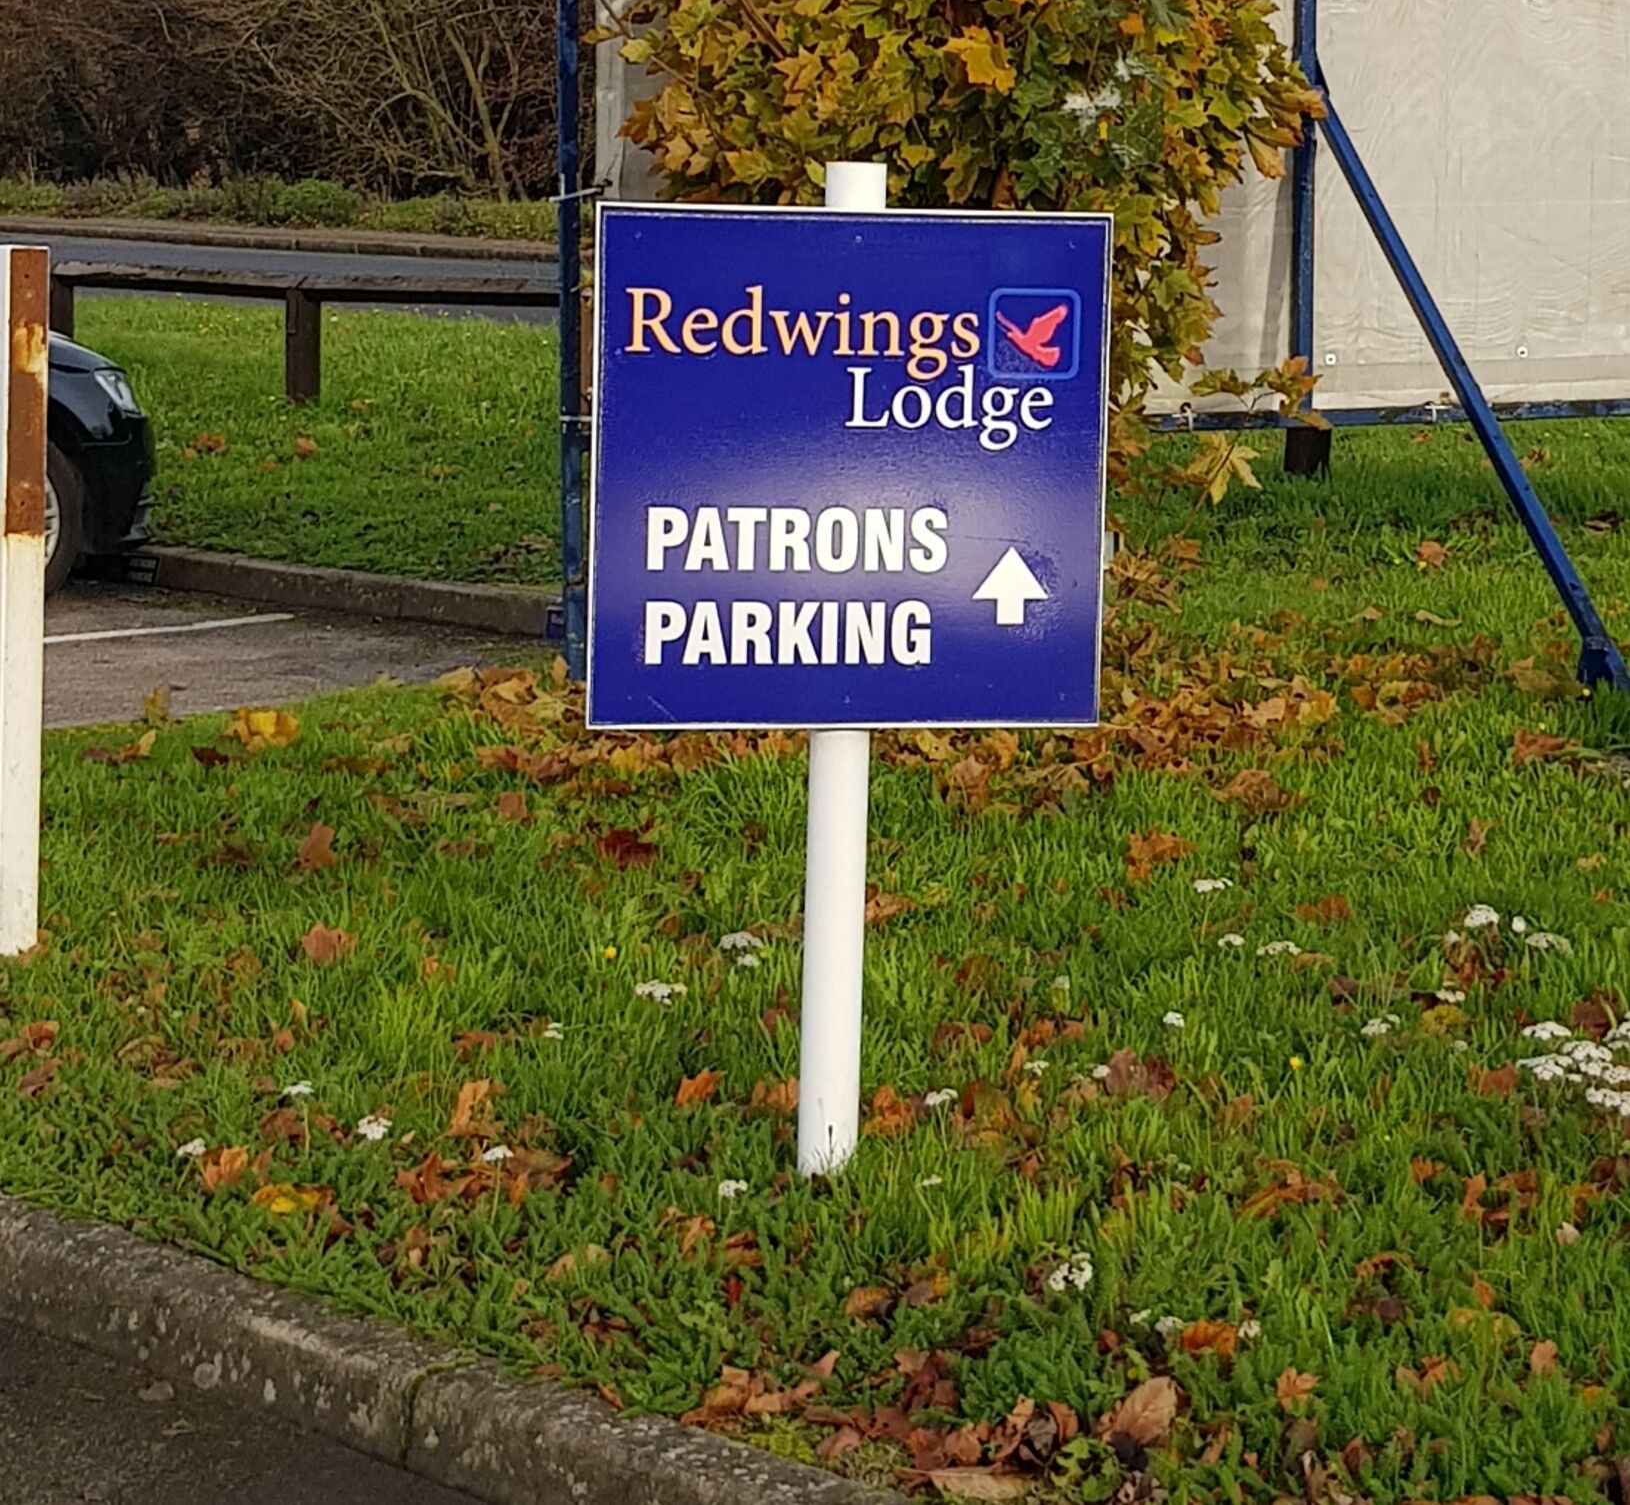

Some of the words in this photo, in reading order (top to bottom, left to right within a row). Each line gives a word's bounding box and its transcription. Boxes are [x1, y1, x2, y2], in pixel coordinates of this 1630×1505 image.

[625, 285, 981, 380] Redwings
[845, 366, 1054, 450] Lodge
[646, 506, 949, 573] PATRONS
[643, 600, 932, 665] PARKING
